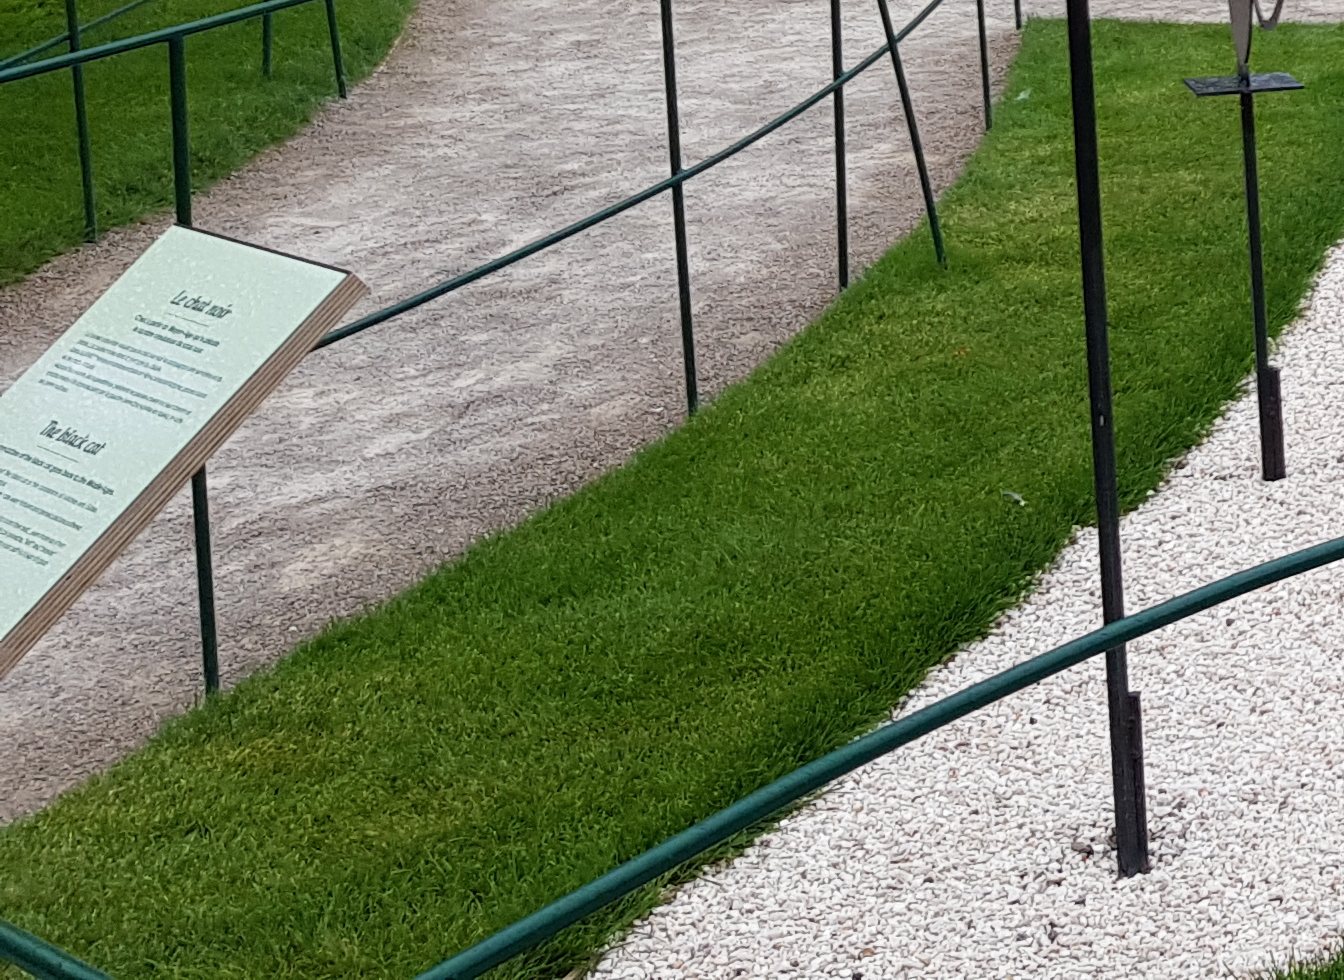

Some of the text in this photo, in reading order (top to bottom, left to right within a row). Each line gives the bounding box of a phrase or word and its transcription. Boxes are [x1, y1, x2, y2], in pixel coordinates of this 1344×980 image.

[169, 289, 188, 306] Le
[39, 419, 107, 456] The black cat
